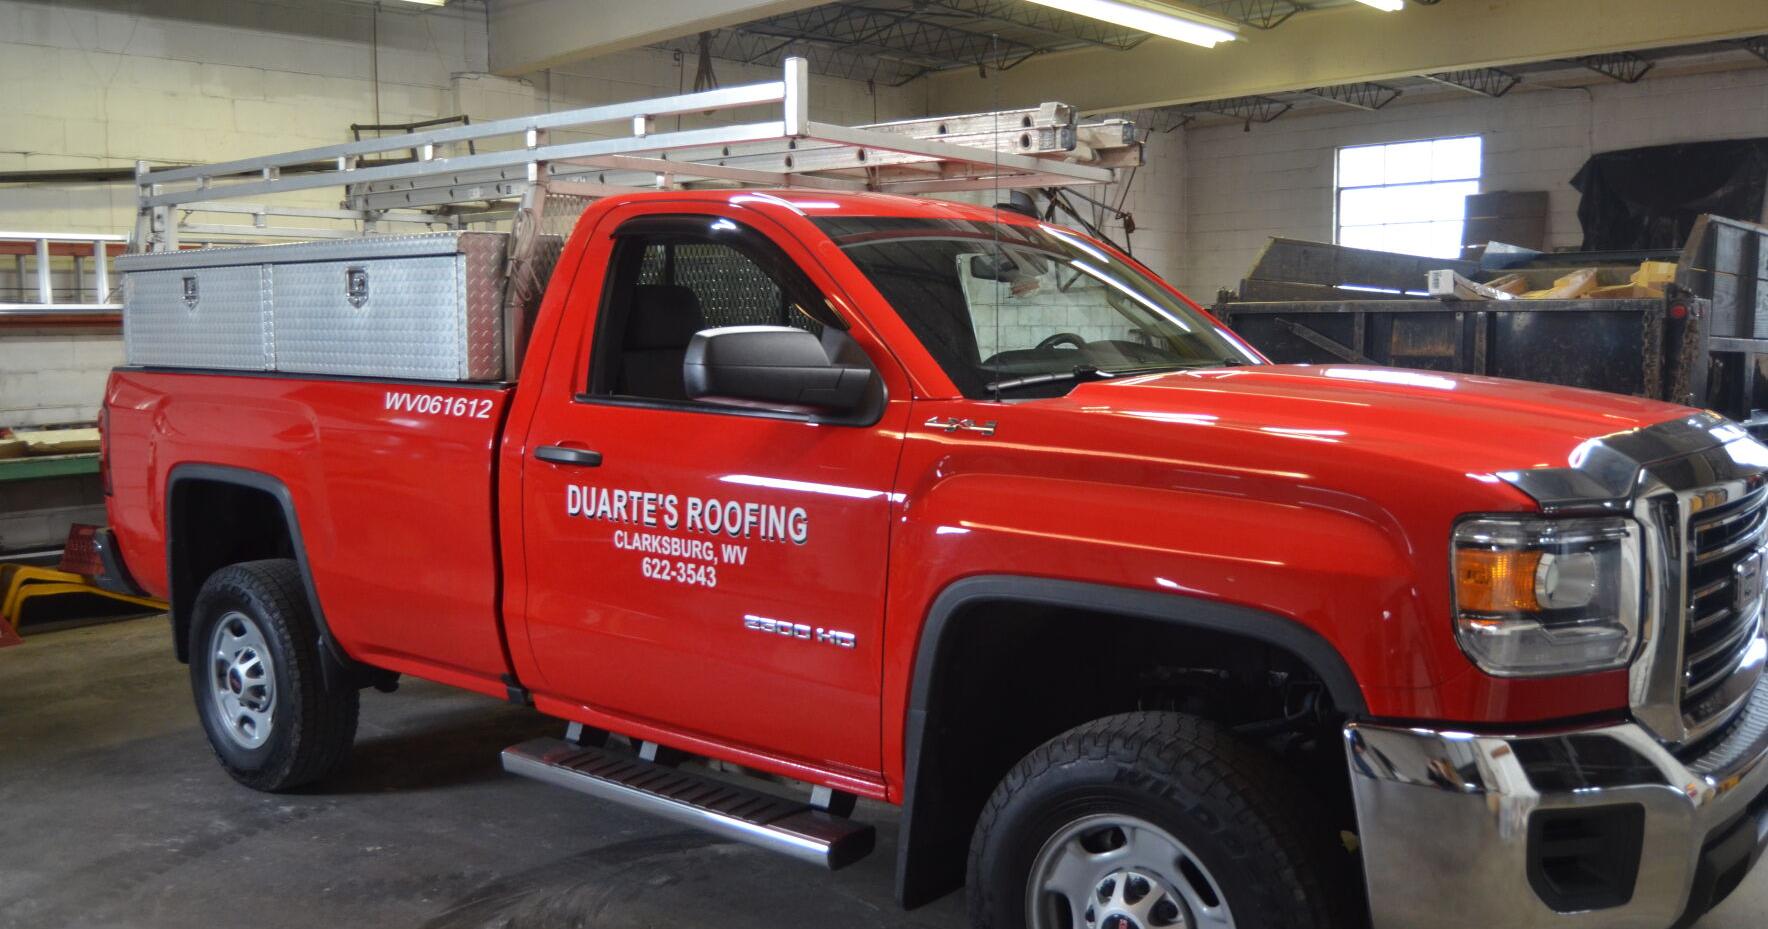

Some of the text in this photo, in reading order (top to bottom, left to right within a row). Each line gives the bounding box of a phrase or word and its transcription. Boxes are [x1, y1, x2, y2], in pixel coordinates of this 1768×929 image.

[385, 391, 493, 419] WV061612
[567, 484, 808, 545] DUARTE'S ROOFING
[614, 530, 748, 566] CLARKSBURG, WV
[642, 557, 717, 588] 622-3543
